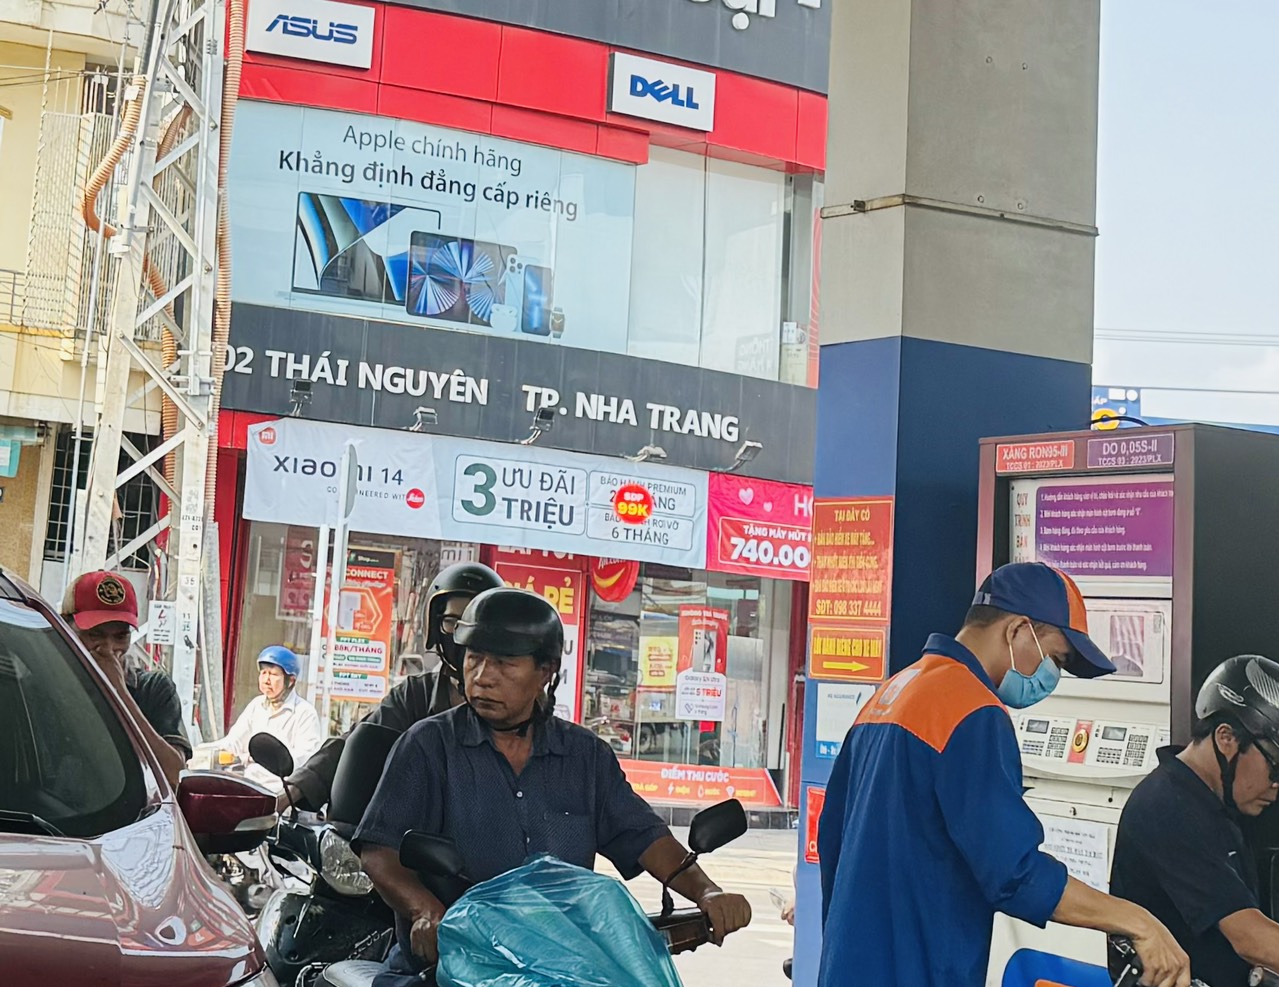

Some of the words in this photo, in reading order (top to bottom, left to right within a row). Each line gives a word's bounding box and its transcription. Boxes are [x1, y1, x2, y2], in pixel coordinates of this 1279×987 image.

[265, 14, 358, 45] ASUS
[630, 74, 699, 110] DELL
[343, 125, 405, 152] Apple
[411, 135, 466, 162] chính
[473, 145, 522, 176] hãng
[279, 150, 355, 183] Khẳng
[363, 161, 413, 188] định
[420, 169, 476, 202] đẳng
[482, 181, 519, 209] cấp
[525, 190, 578, 221] riêng
[265, 350, 349, 387] THÁI
[358, 361, 489, 406] NGUYÊN
[522, 384, 567, 416] TP.
[575, 391, 638, 427] NHA
[646, 402, 739, 443] TRANG
[1102, 442, 1118, 455] DO
[381, 467, 404, 486] 14
[460, 462, 498, 516] 3
[502, 466, 533, 489] ƯU
[539, 470, 575, 495] ĐÃI
[647, 482, 687, 496] PREMIUM
[501, 497, 575, 530] TRIỆU
[617, 502, 649, 517] 99K
[611, 526, 620, 539] 6
[623, 526, 669, 545] THÁNG
[743, 524, 768, 538] TẶNG
[768, 527, 787, 541] MÁY
[788, 528, 806, 542] HÚT
[686, 772, 704, 782] THU
